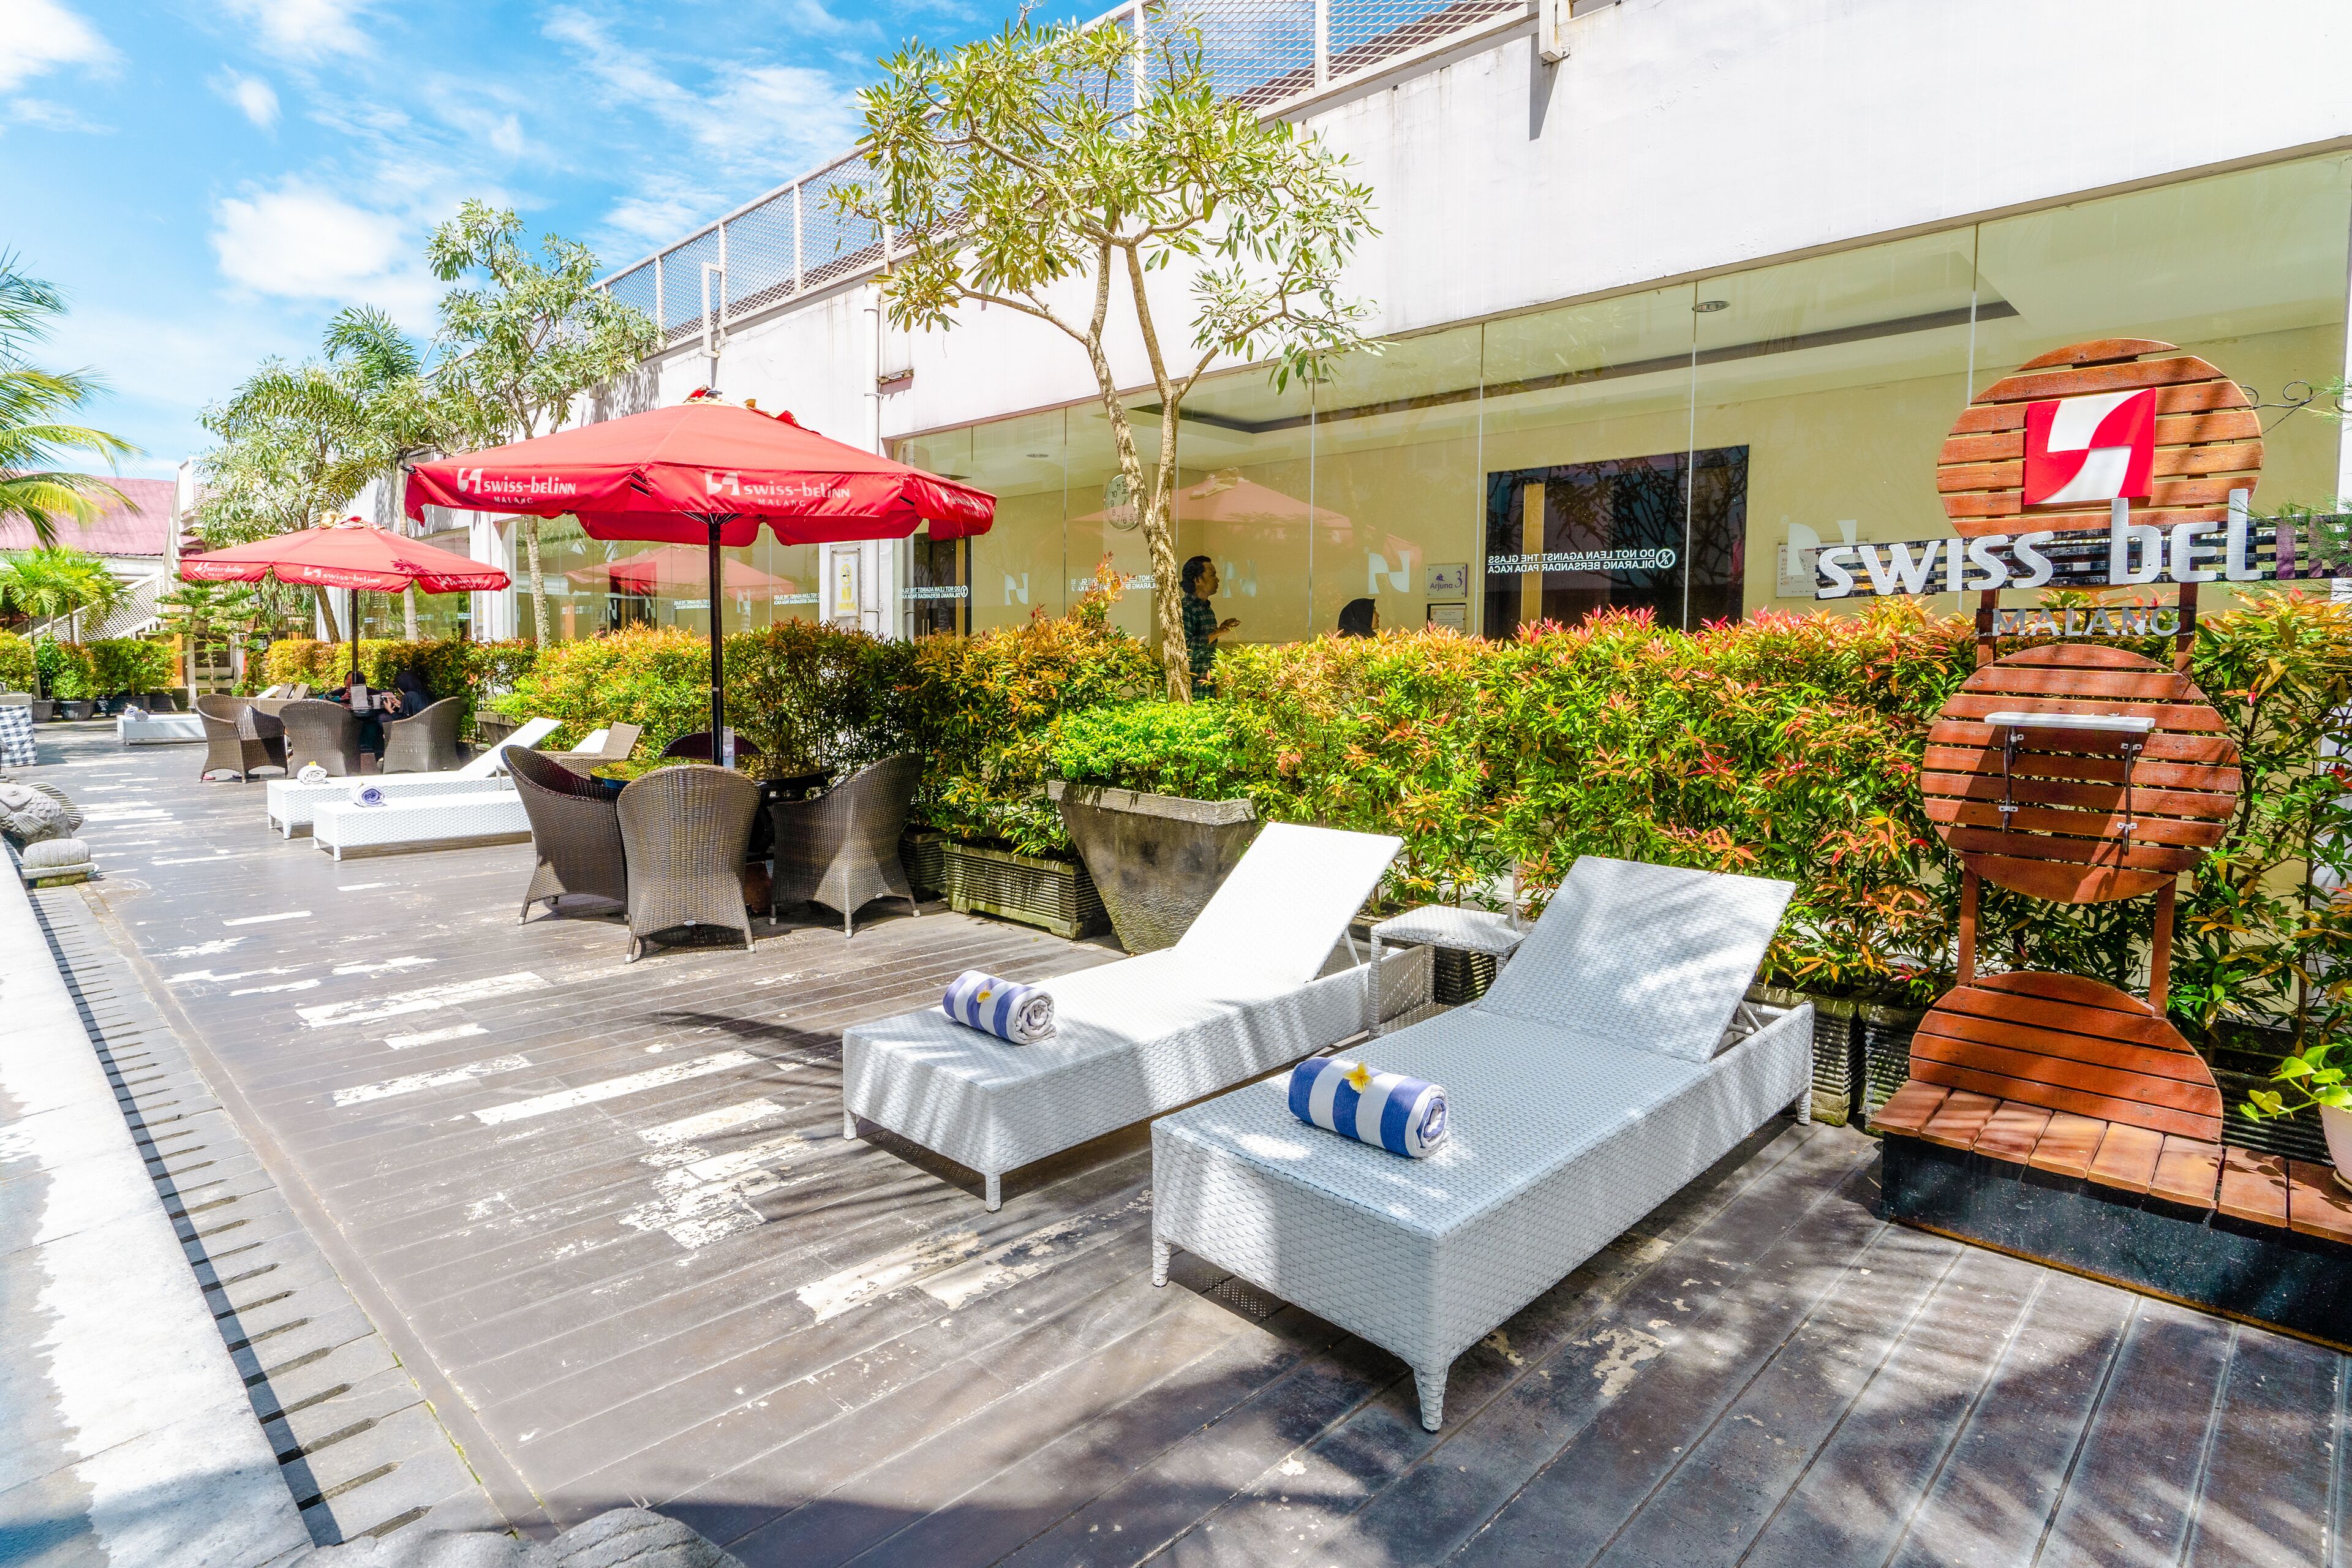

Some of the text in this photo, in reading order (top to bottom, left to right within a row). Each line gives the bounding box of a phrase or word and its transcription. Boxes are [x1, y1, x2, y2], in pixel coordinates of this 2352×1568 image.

[758, 499, 806, 507] MALANG
[1455, 570, 1463, 588] 3
[1430, 582, 1453, 592] Arjuna
[1991, 606, 2181, 637] MALANG
